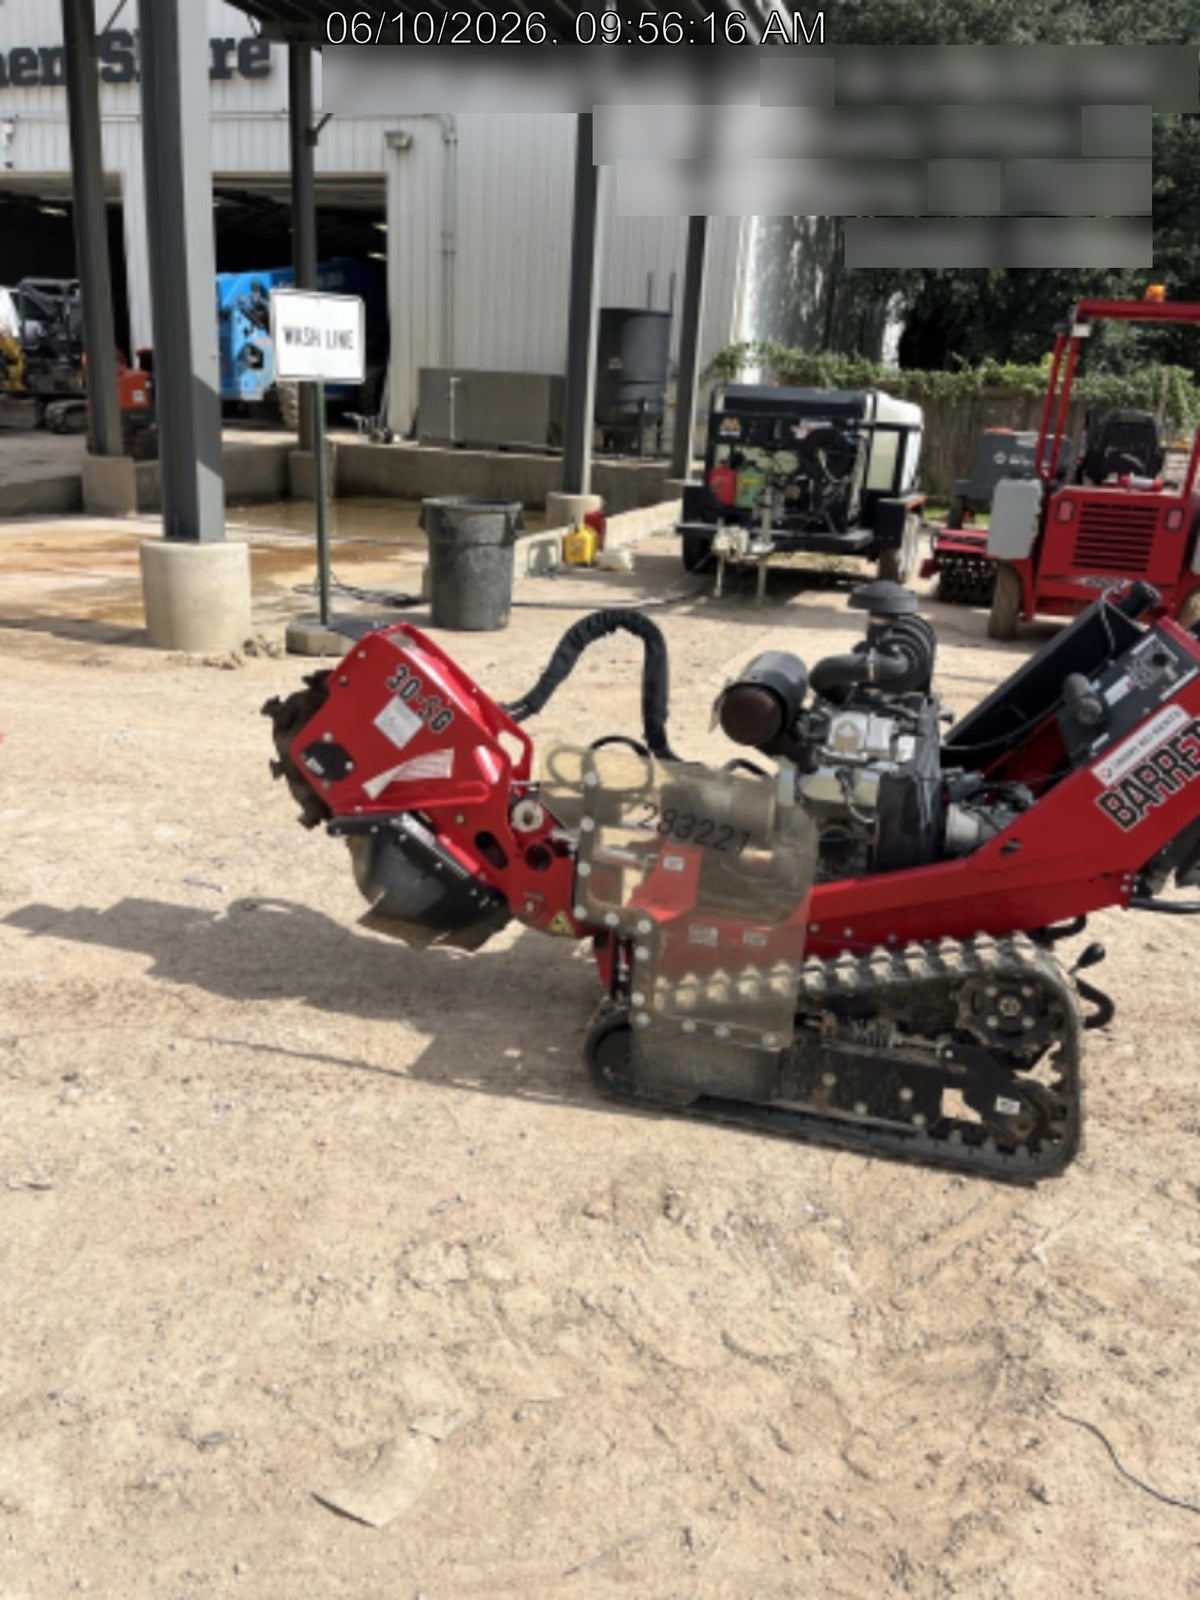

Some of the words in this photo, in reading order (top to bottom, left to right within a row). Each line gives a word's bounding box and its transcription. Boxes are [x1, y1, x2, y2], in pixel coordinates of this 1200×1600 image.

[99, 28, 271, 84] Sre
[283, 326, 322, 347] WASH
[326, 329, 354, 351] LINE
